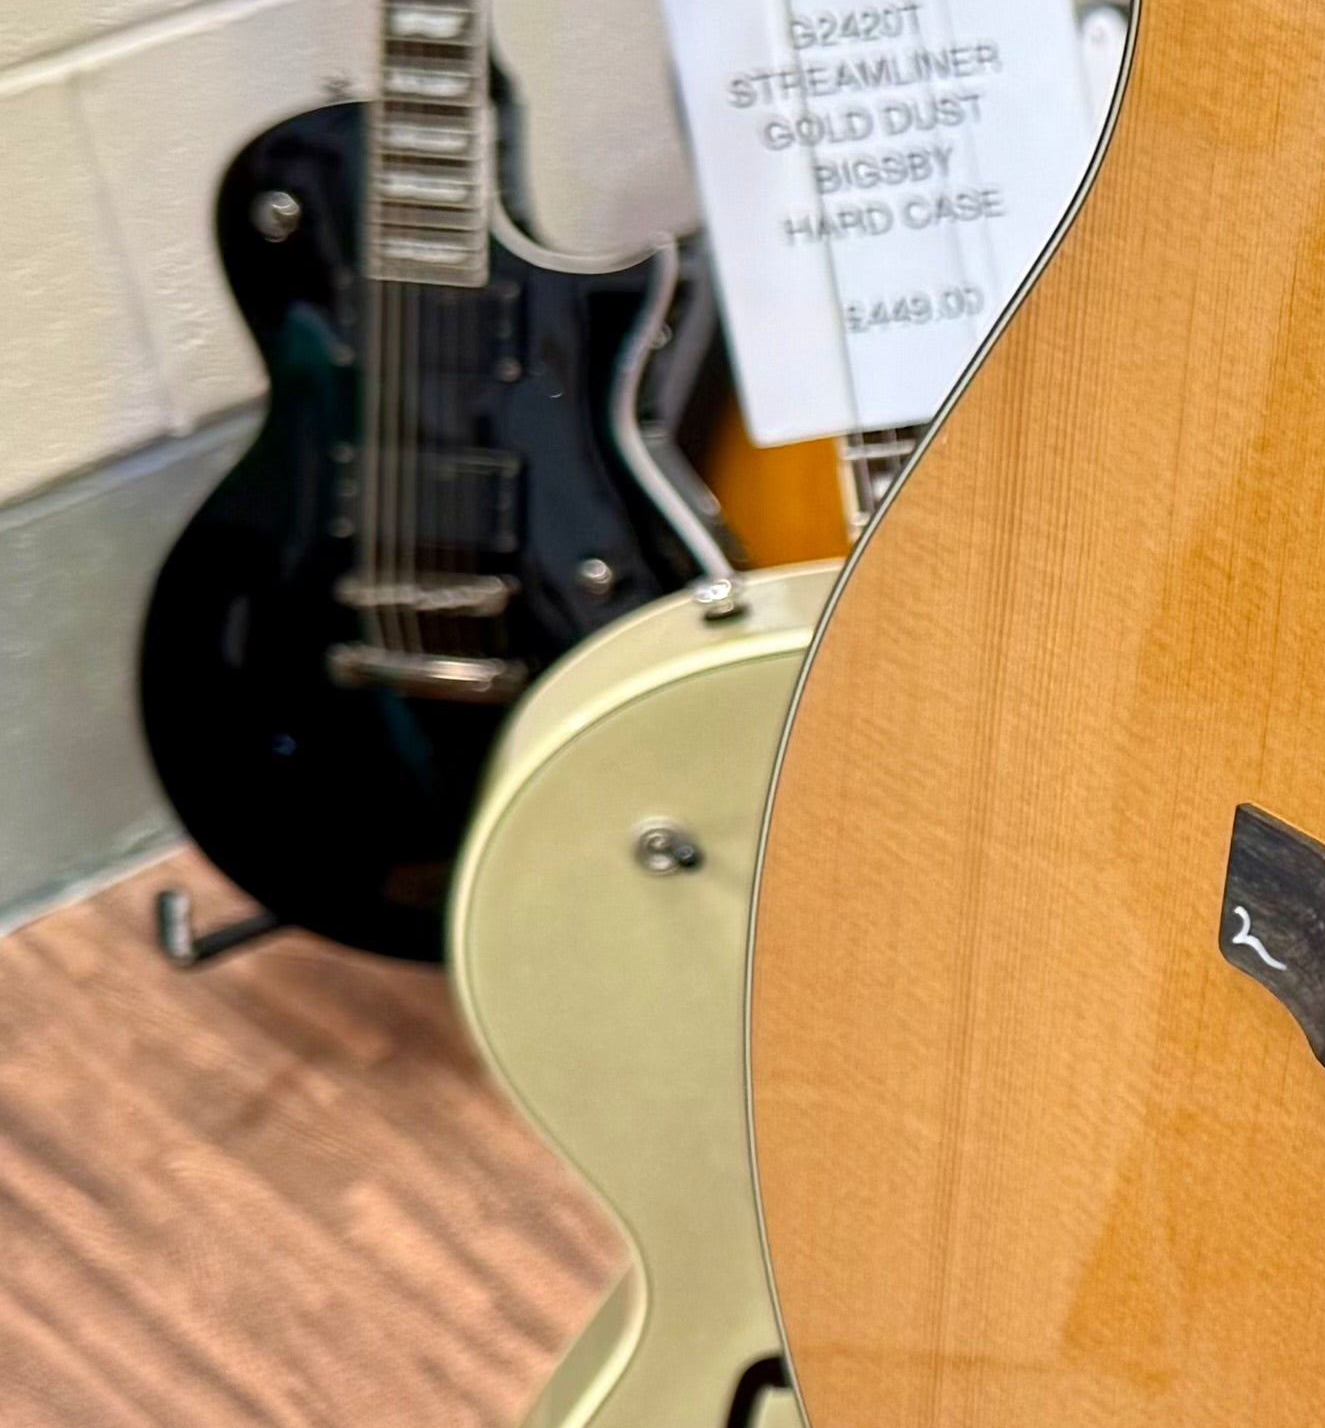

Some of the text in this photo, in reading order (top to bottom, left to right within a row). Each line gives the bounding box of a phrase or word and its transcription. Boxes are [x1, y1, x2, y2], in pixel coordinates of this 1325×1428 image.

[790, 5, 922, 51] G2420T
[727, 44, 1003, 110] STREAMLINER
[763, 93, 985, 153] GOLD DUST
[815, 146, 956, 196] BIGSBY
[783, 188, 1007, 248] HARD CASE
[845, 286, 986, 335] £449.00
